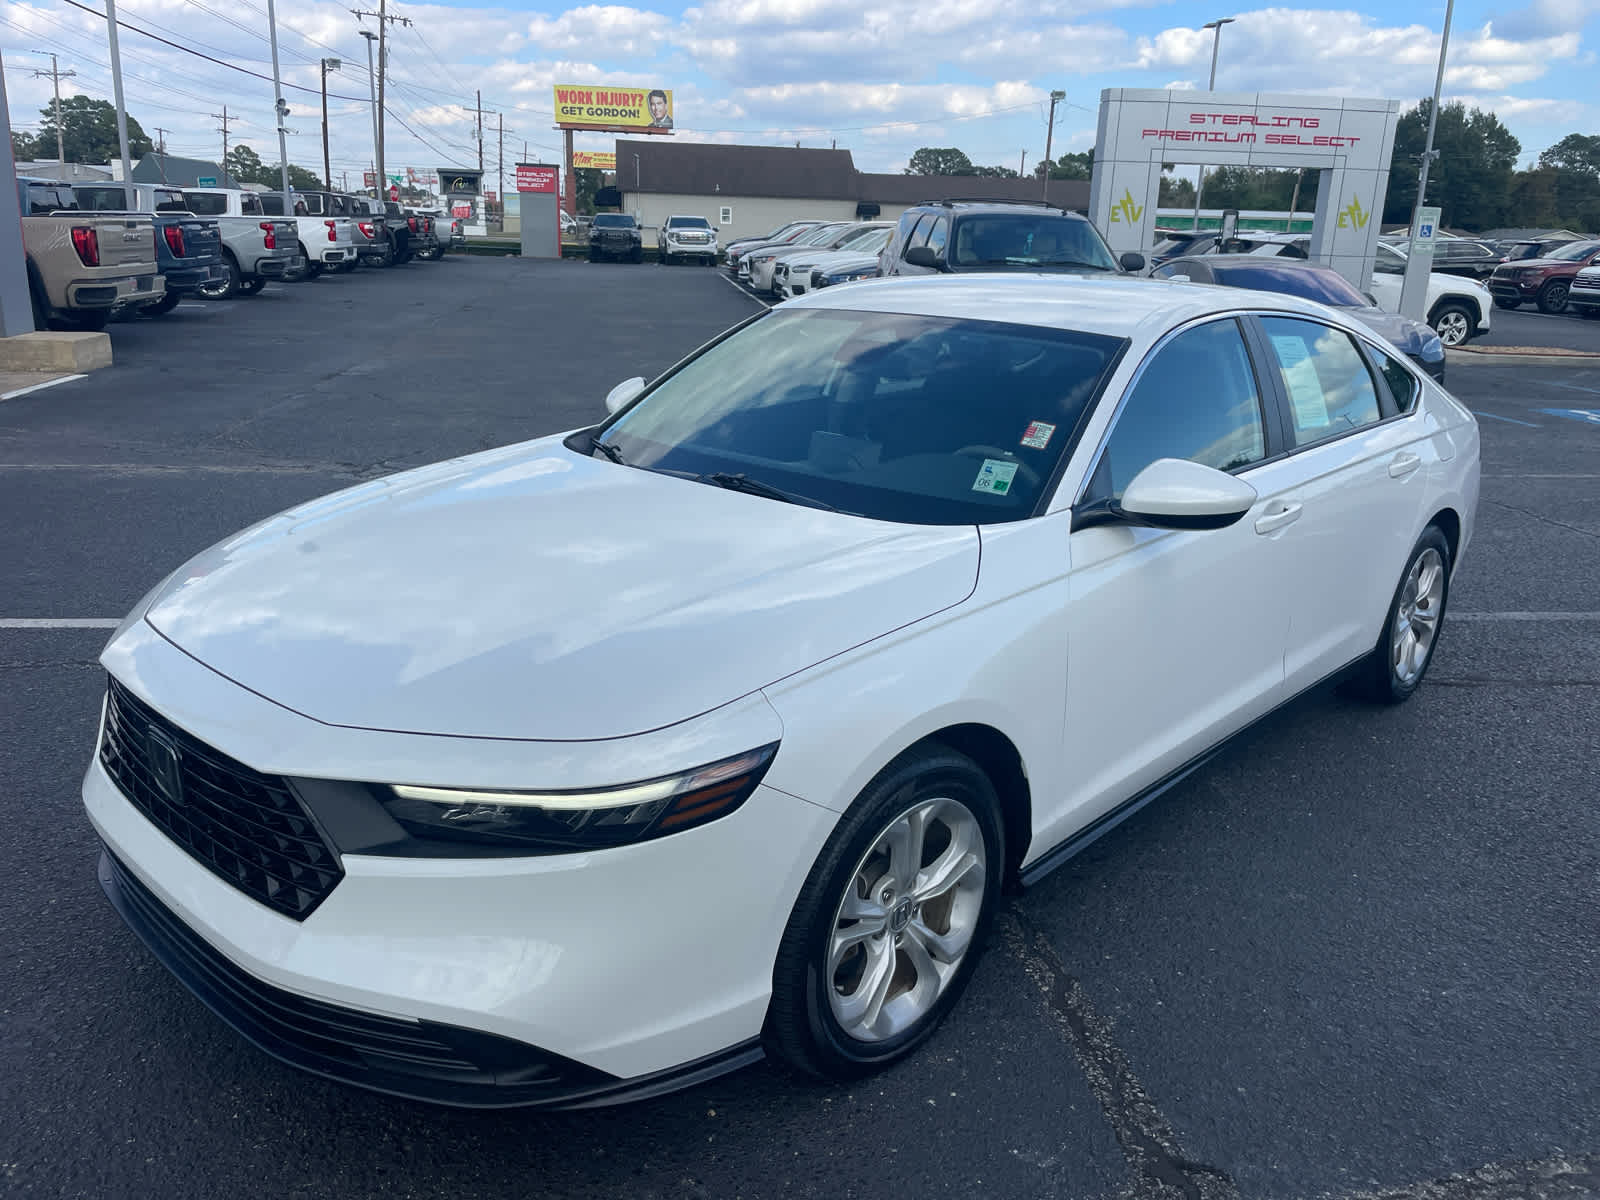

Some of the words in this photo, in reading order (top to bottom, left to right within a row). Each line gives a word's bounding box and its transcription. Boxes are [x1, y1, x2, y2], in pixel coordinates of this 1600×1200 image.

[557, 89, 593, 105] WORK
[596, 91, 644, 107] INJURY?
[561, 106, 583, 116] GET
[587, 107, 640, 119] GORDON!
[1189, 112, 1321, 129] STERLING
[1142, 129, 1257, 144] PREMIUM
[1264, 133, 1361, 147] SELECT
